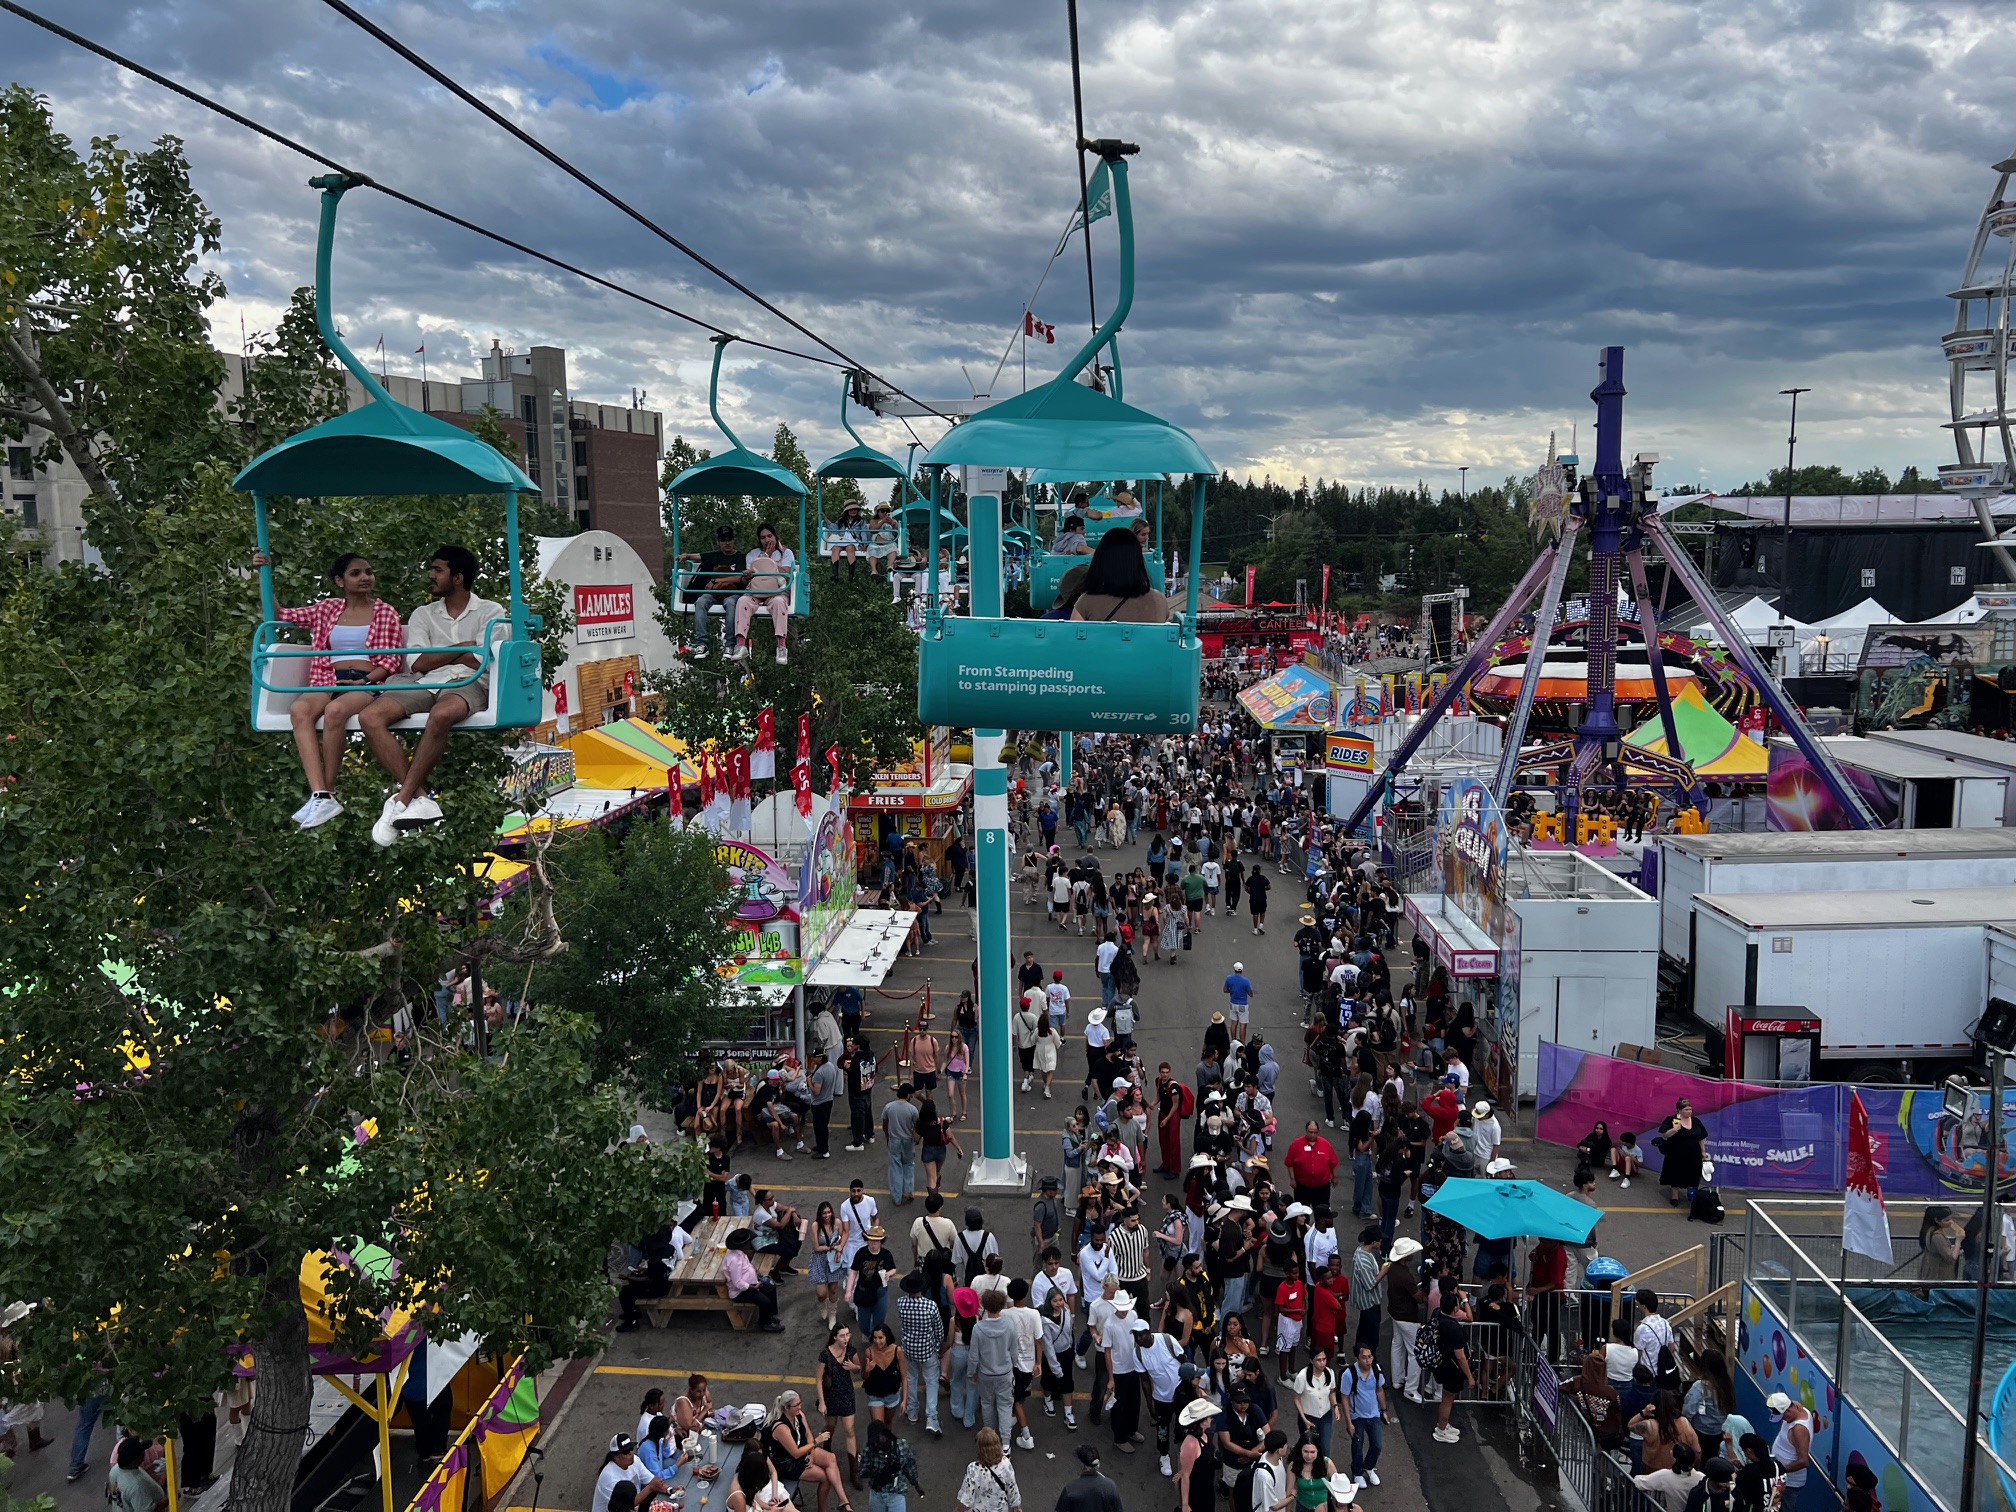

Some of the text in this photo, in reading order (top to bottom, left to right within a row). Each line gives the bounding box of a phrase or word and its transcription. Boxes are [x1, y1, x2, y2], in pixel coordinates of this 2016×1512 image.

[578, 593, 631, 617] LAMMLE'S
[587, 625, 627, 637] WESTERN WEAR
[1778, 637, 1785, 646] 6
[958, 664, 1074, 682] From Stampeding
[958, 679, 1106, 696] to stamping passports.
[1090, 711, 1144, 722] WESTJET
[1168, 713, 1191, 725] 30
[1330, 747, 1369, 763] RIDES
[868, 796, 905, 805] FRIES
[928, 797, 943, 805] COLD
[986, 831, 995, 844] 8
[1454, 826, 1492, 878] CREAM
[1456, 957, 1493, 970] Ice Cream
[726, 1049, 750, 1057] Some
[1713, 1153, 1741, 1165] MAKE
[1742, 1156, 1764, 1167] YOU
[1765, 1143, 1814, 1163] SMILE!
